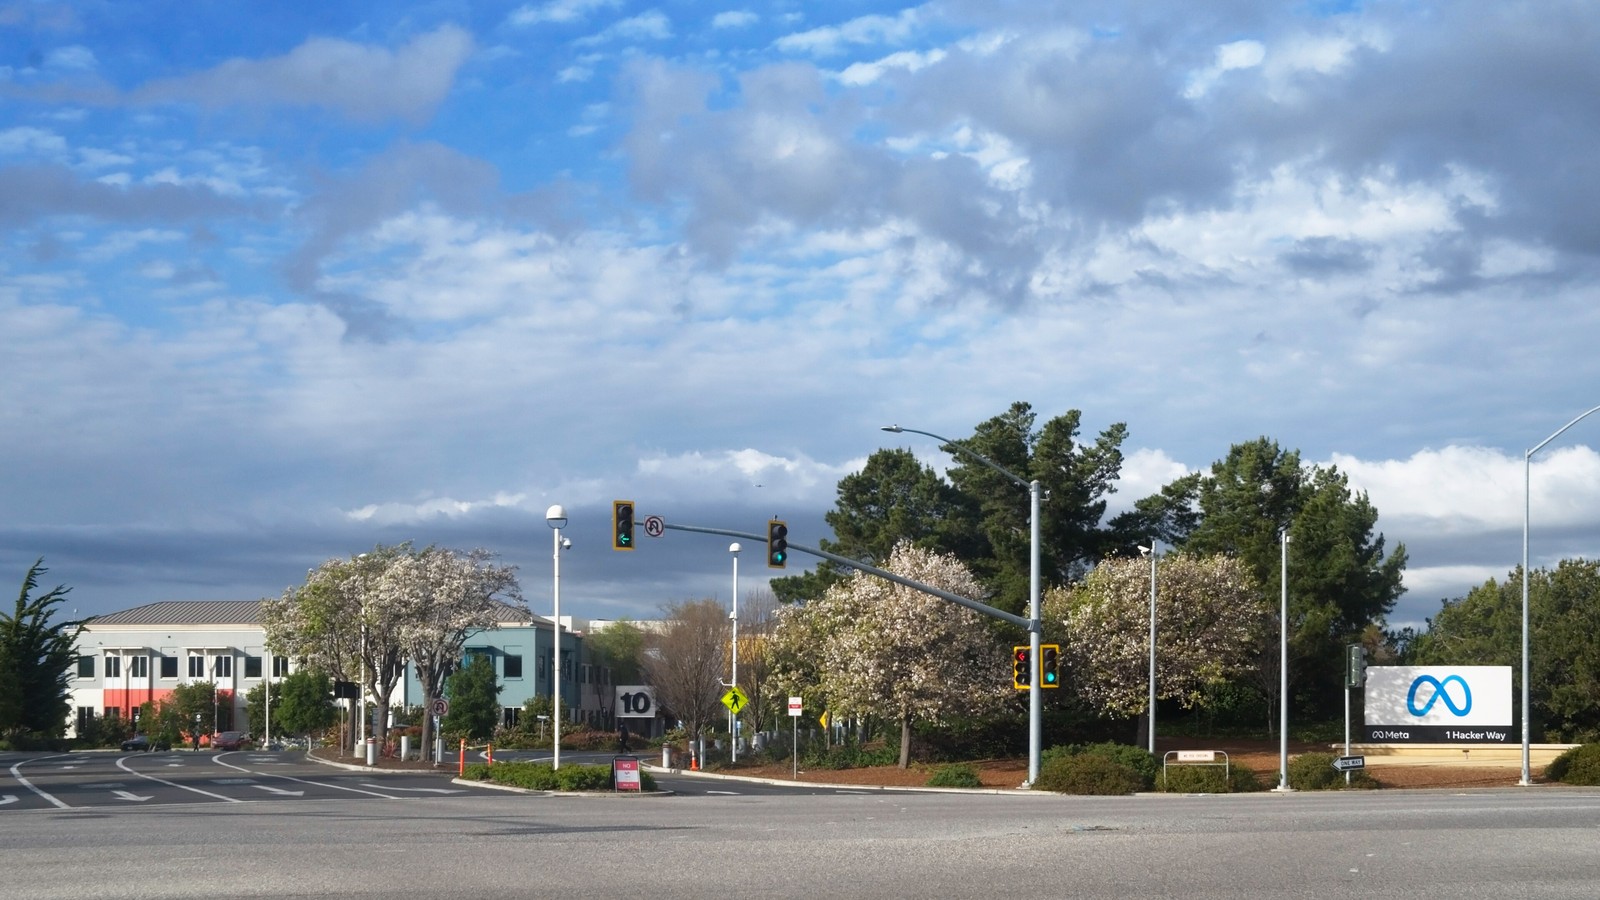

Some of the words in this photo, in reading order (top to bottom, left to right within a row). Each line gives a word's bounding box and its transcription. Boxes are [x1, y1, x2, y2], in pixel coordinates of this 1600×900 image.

[620, 692, 651, 714] 10
[1385, 731, 1410, 739] Meta
[1445, 731, 1451, 739] 1
[1452, 731, 1485, 739] Hacker
[1486, 731, 1506, 741] Way
